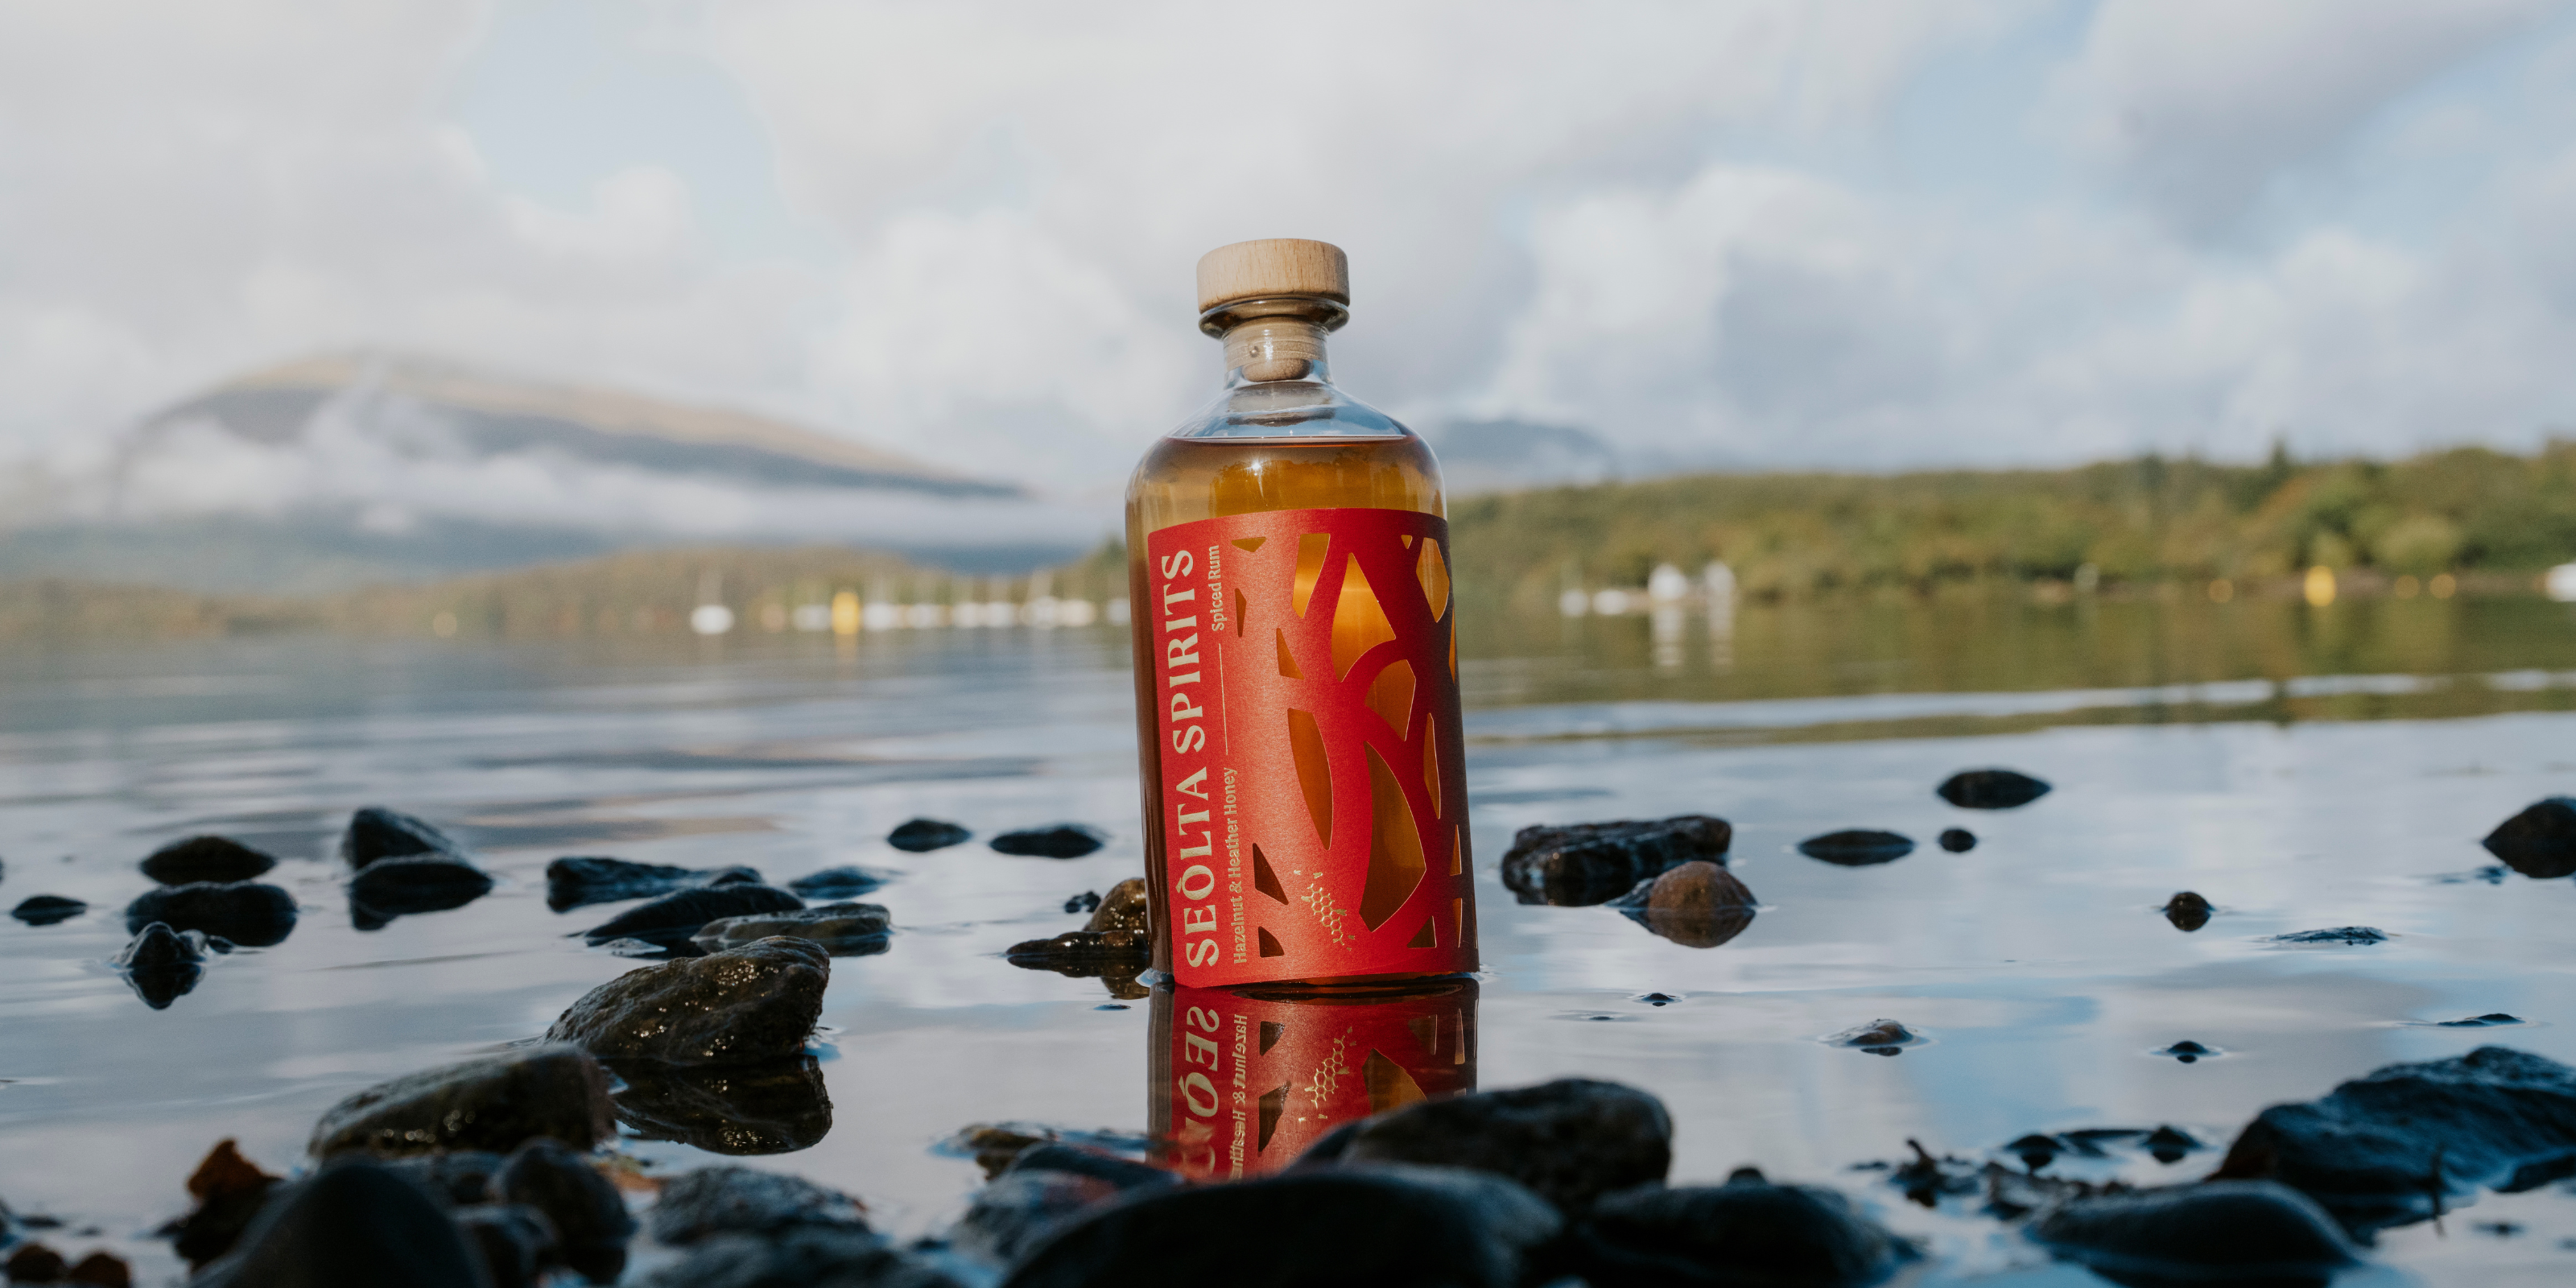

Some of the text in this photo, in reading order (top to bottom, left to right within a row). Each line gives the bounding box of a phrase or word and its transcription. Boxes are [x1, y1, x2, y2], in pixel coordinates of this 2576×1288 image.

[1208, 545, 1228, 631] Spiced Rum
[1161, 550, 1220, 968] SEÒLTA SPIRITS
[1224, 767, 1247, 964] Hazelnut & Heather Honey
